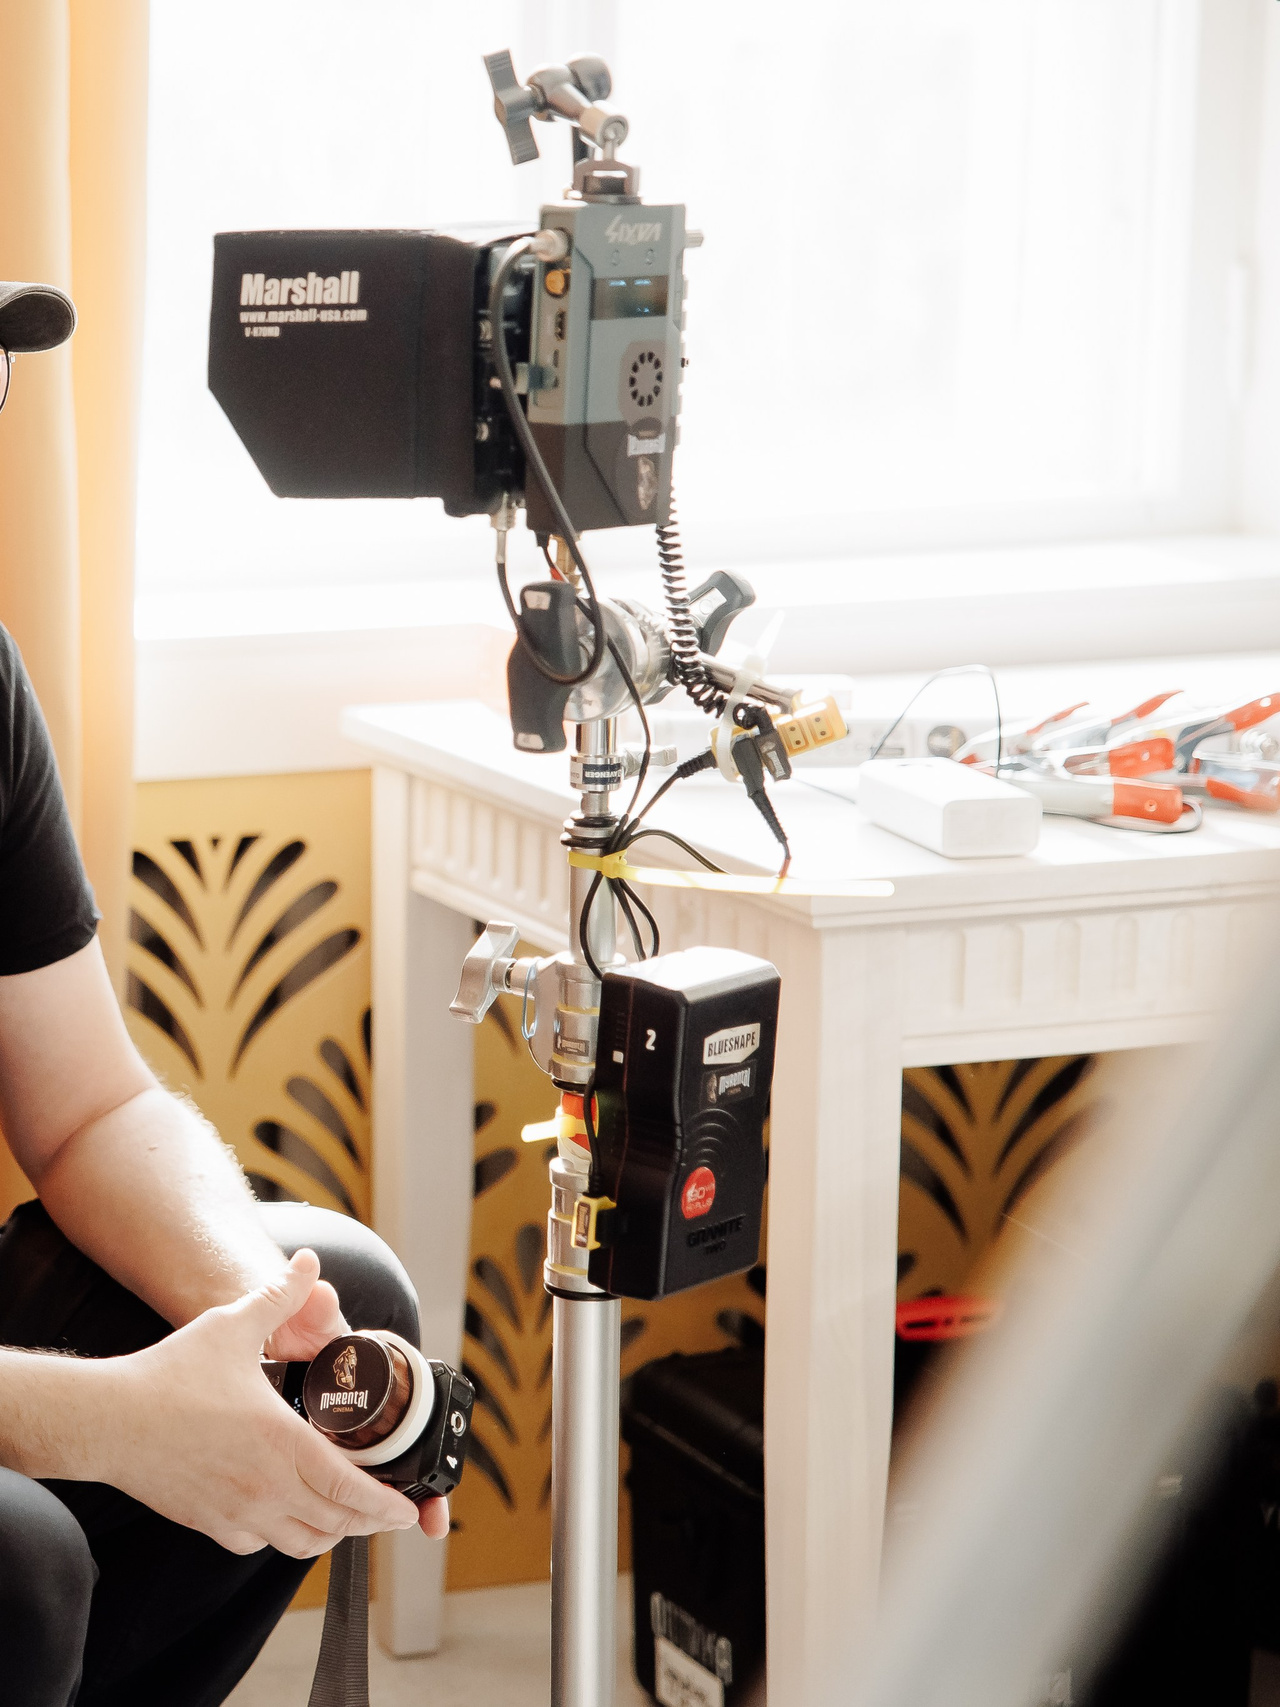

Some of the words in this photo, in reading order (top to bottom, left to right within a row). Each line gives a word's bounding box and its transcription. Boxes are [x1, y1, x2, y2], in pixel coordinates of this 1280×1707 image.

[240, 270, 360, 306] Marshall
[239, 308, 368, 323] www.marshall-usa.com
[645, 1029, 657, 1051] 2
[707, 1031, 756, 1058] BLUESHAPE
